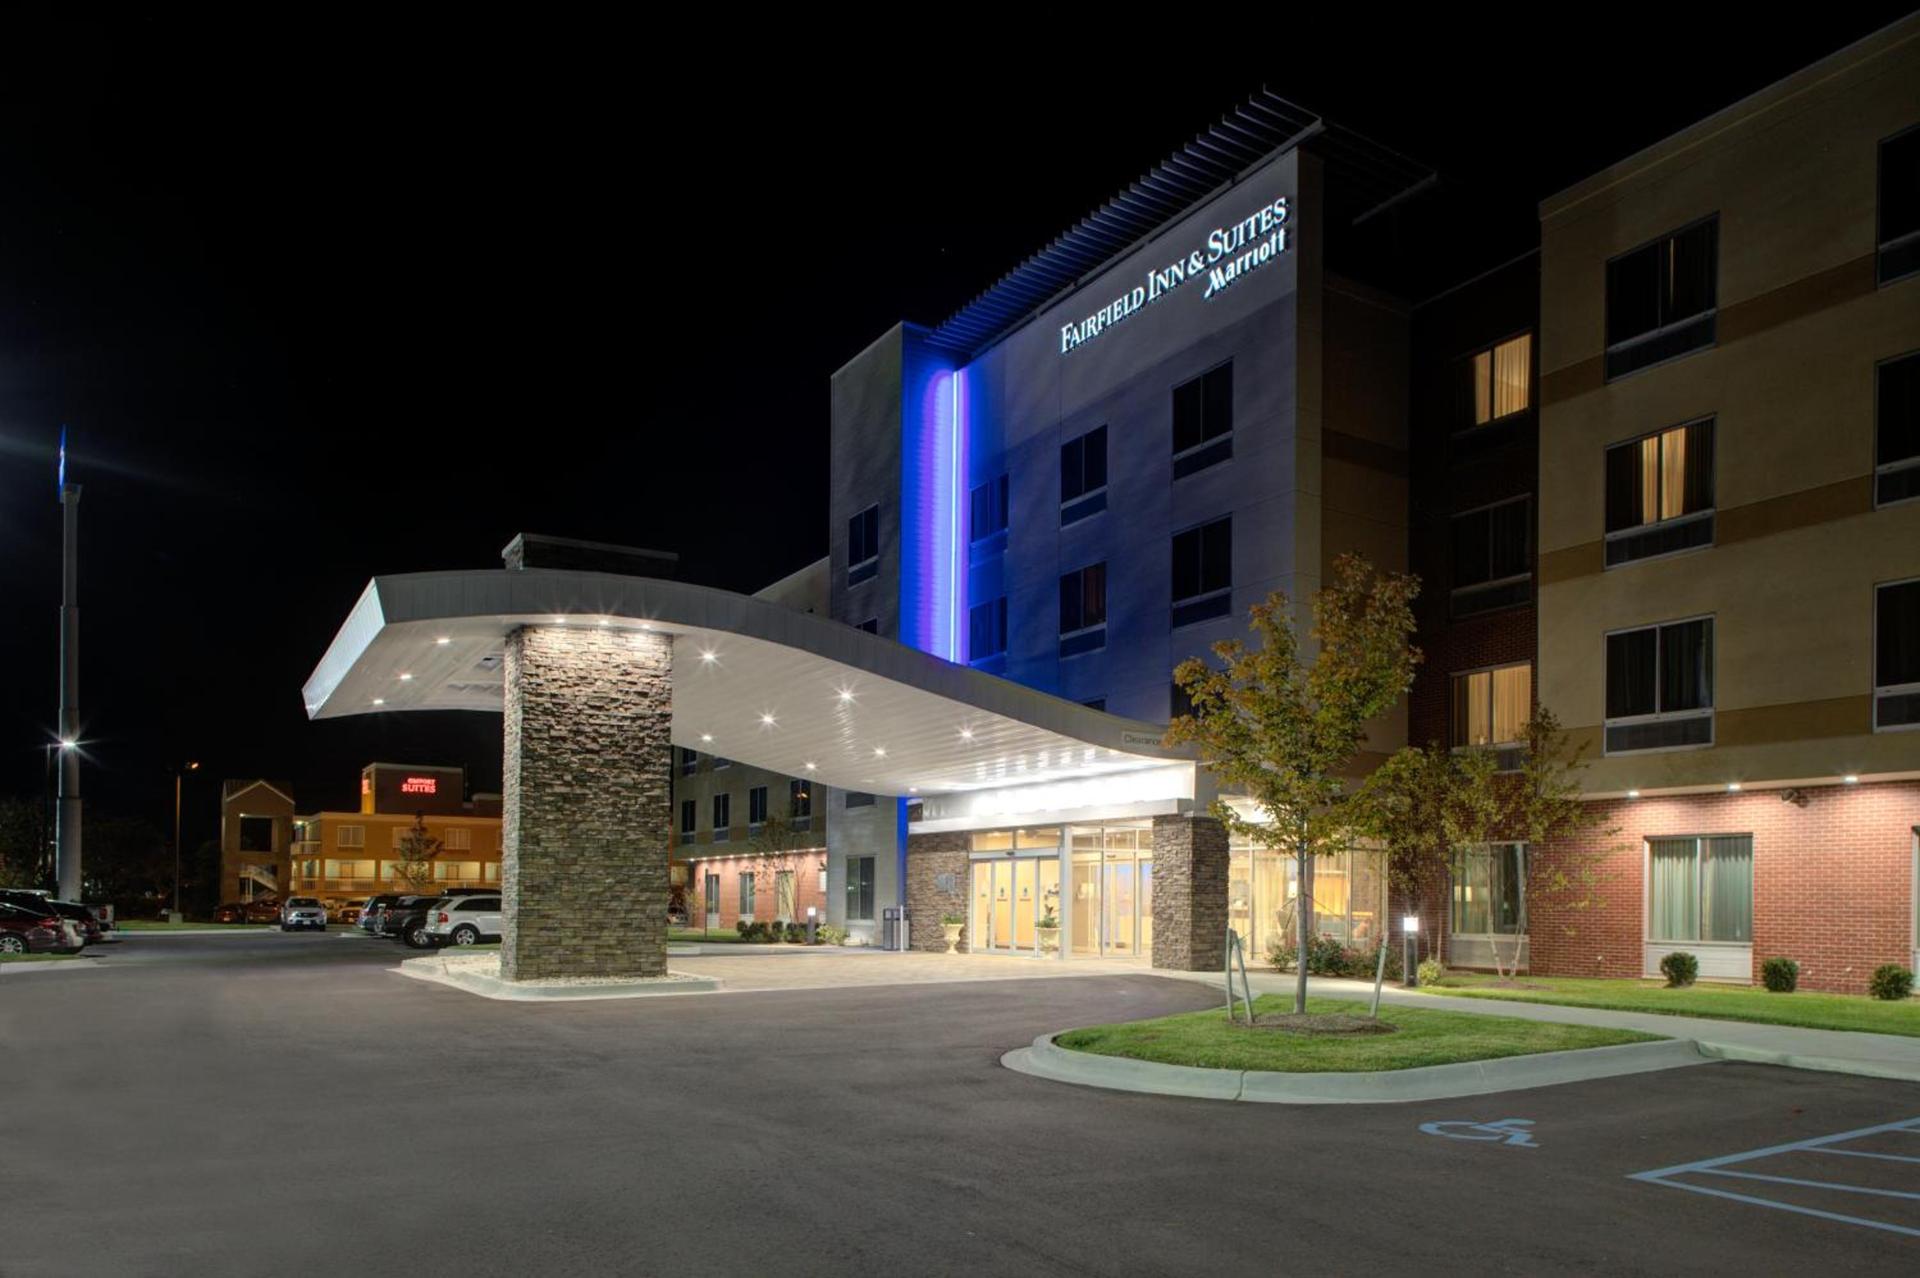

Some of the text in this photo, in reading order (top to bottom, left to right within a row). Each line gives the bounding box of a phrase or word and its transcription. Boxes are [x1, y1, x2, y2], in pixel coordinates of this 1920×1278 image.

[1060, 197, 1287, 353] FAIRFIELD INN & SUITES
[1204, 228, 1287, 299] Marriott
